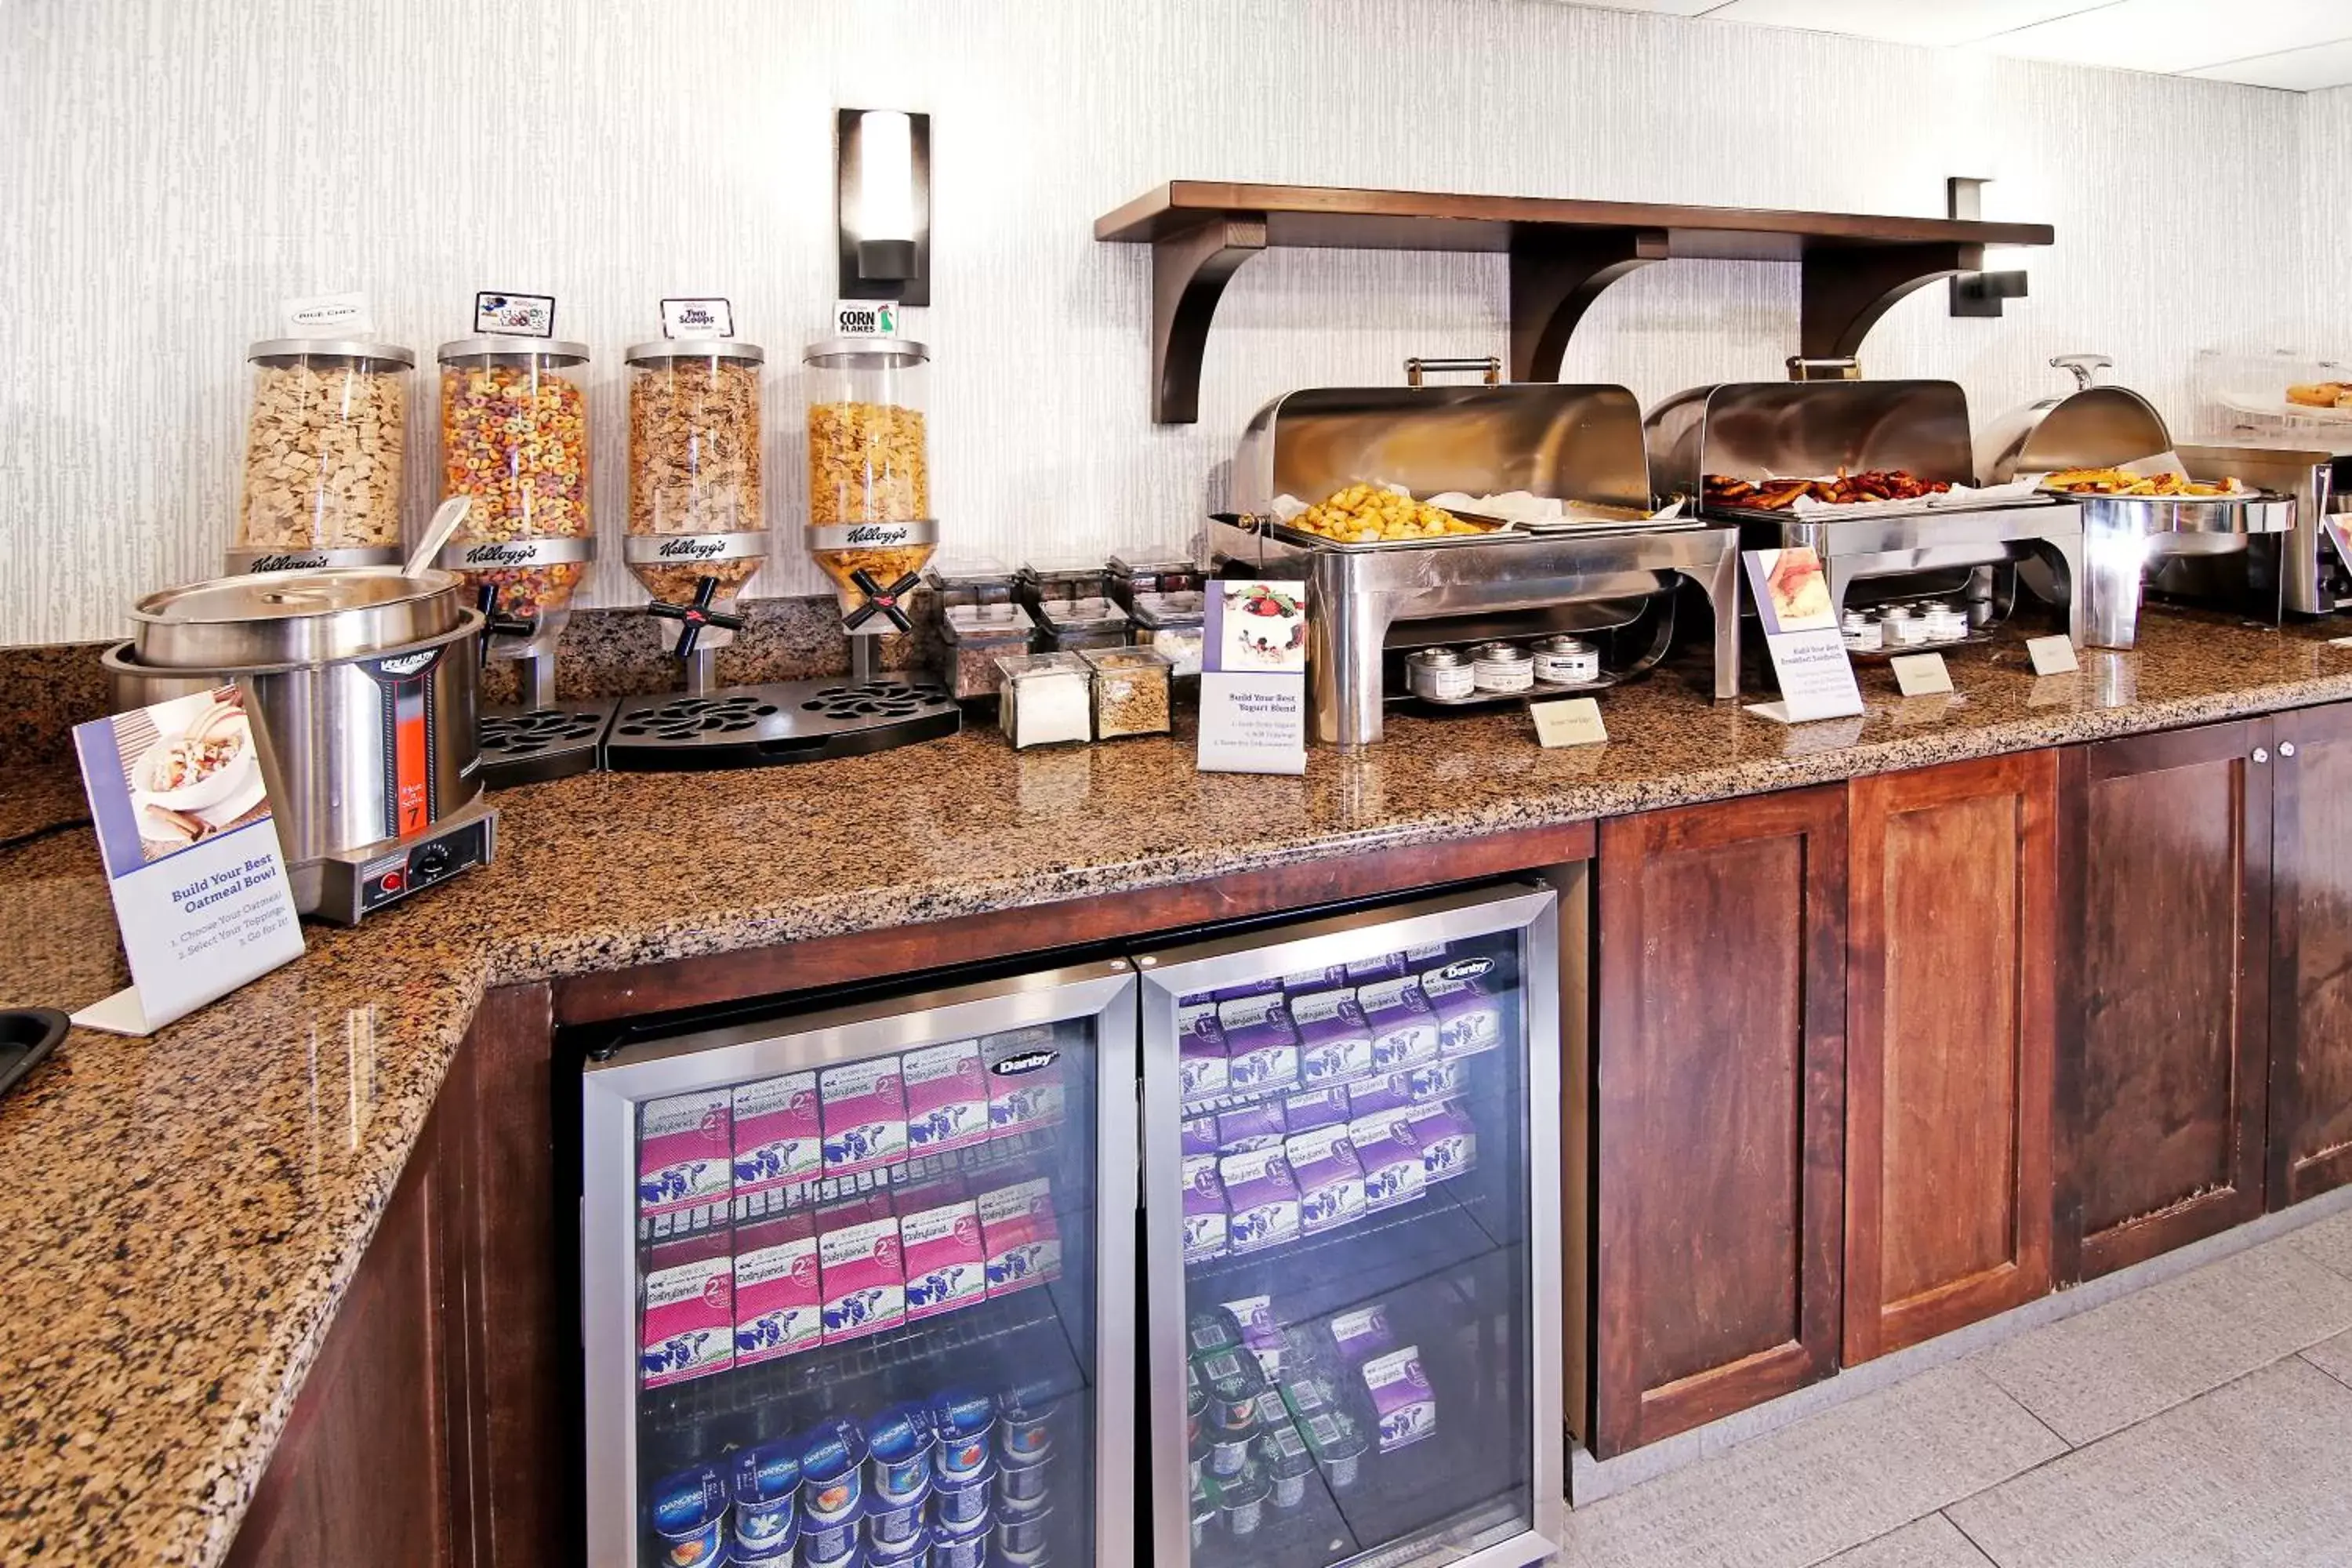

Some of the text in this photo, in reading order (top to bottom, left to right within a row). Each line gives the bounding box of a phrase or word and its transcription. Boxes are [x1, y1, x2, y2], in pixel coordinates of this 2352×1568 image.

[840, 311, 875, 325] CORN
[847, 527, 907, 543] Kellogg's
[466, 545, 538, 564] Kellogg's
[659, 539, 726, 557] Kellogg's
[1239, 704, 1268, 713] Yogurt
[408, 808, 419, 828] 7
[172, 854, 273, 902] Build Your Best
[184, 866, 277, 913] Oatmeal Bowl
[180, 921, 217, 942] Choose
[218, 910, 241, 924] Your
[187, 936, 219, 956] Select
[219, 925, 242, 940] Your
[248, 931, 261, 942] Go
[1449, 962, 1490, 978] Danby
[1000, 1053, 1051, 1073] Danby
[659, 1490, 703, 1513] DANONE
